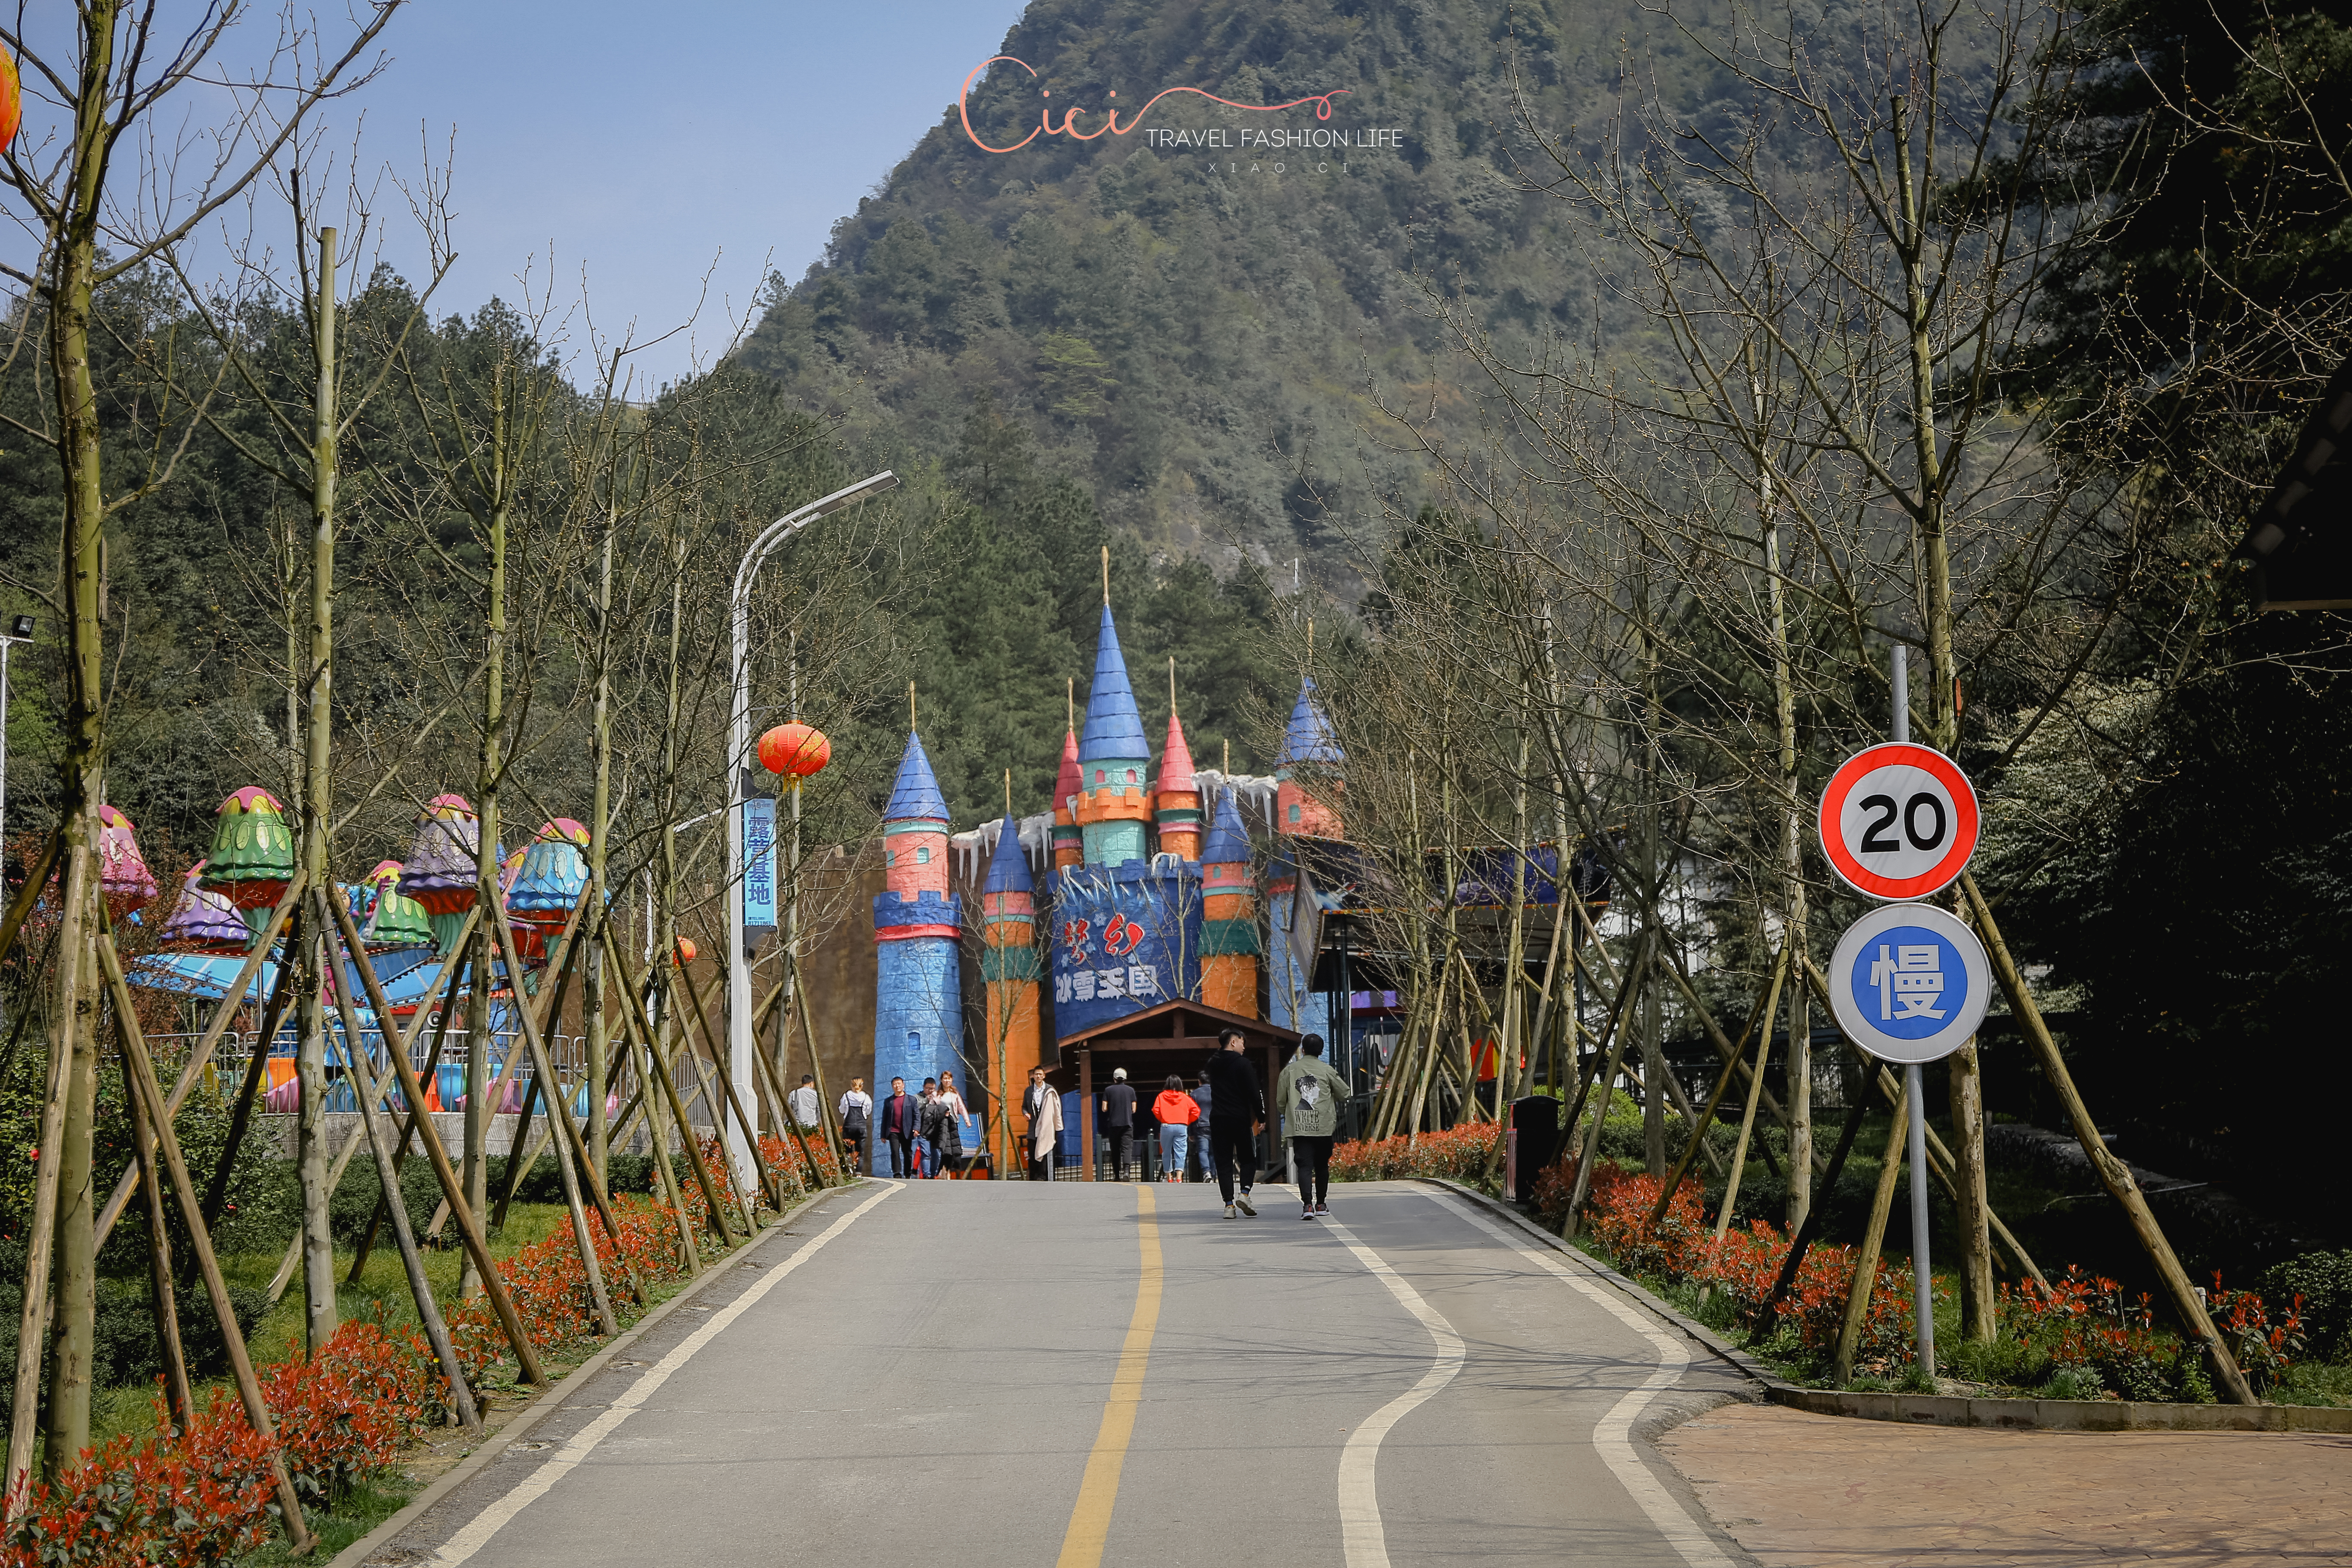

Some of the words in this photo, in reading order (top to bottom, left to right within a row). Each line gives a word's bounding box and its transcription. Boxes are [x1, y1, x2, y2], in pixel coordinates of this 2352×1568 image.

[1858, 792, 1947, 853] 20
[747, 817, 771, 905] 露营基地
[1055, 966, 1158, 1003] 冰雪王国
[1870, 944, 1947, 1020] 慢
[1295, 1124, 1320, 1132] INVERSE
